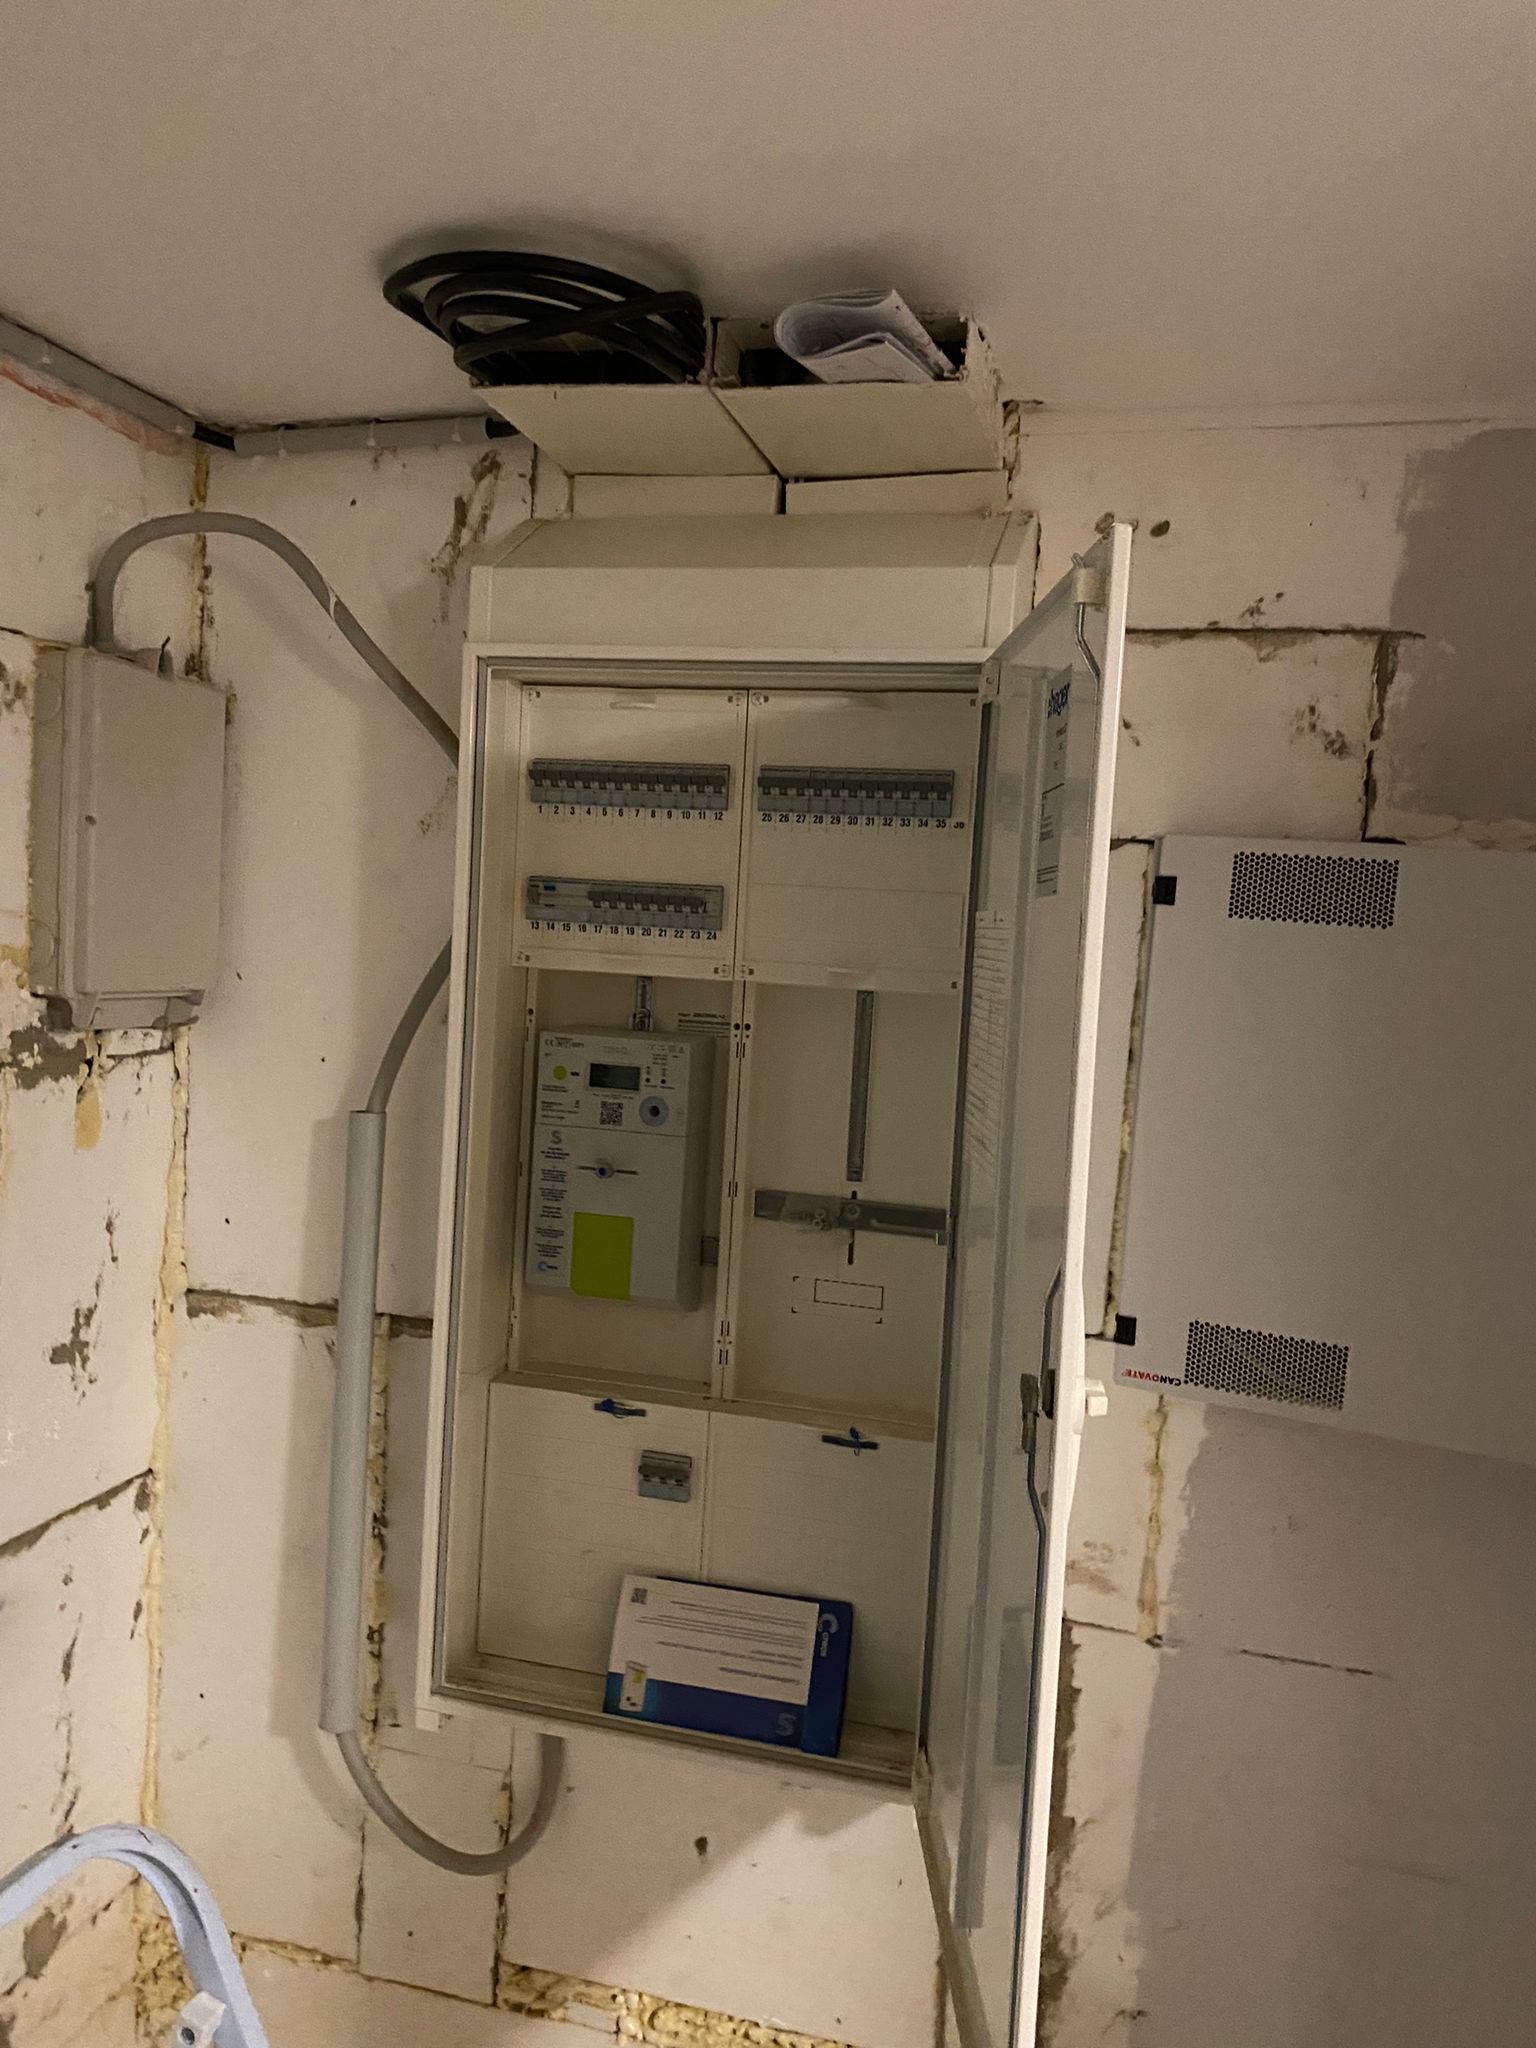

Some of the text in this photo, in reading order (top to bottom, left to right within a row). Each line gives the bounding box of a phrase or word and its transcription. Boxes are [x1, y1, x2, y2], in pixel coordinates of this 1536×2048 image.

[538, 805, 723, 821] 1 2 3 4 5 6 7 8 9 10 11 12
[761, 813, 773, 822] 25
[779, 813, 790, 823] 26
[795, 814, 807, 823] 27
[813, 815, 824, 824] 28
[830, 815, 841, 824] 29
[847, 816, 858, 825] 30
[865, 817, 875, 826] 31
[882, 817, 893, 827] 32
[900, 818, 911, 827] 33
[918, 818, 928, 828] 34
[936, 819, 946, 828] 35
[531, 921, 717, 940] 13 14 15 16 17 18 19 20 21 22 23 24
[1125, 1368, 1182, 1386] CANOVATE
